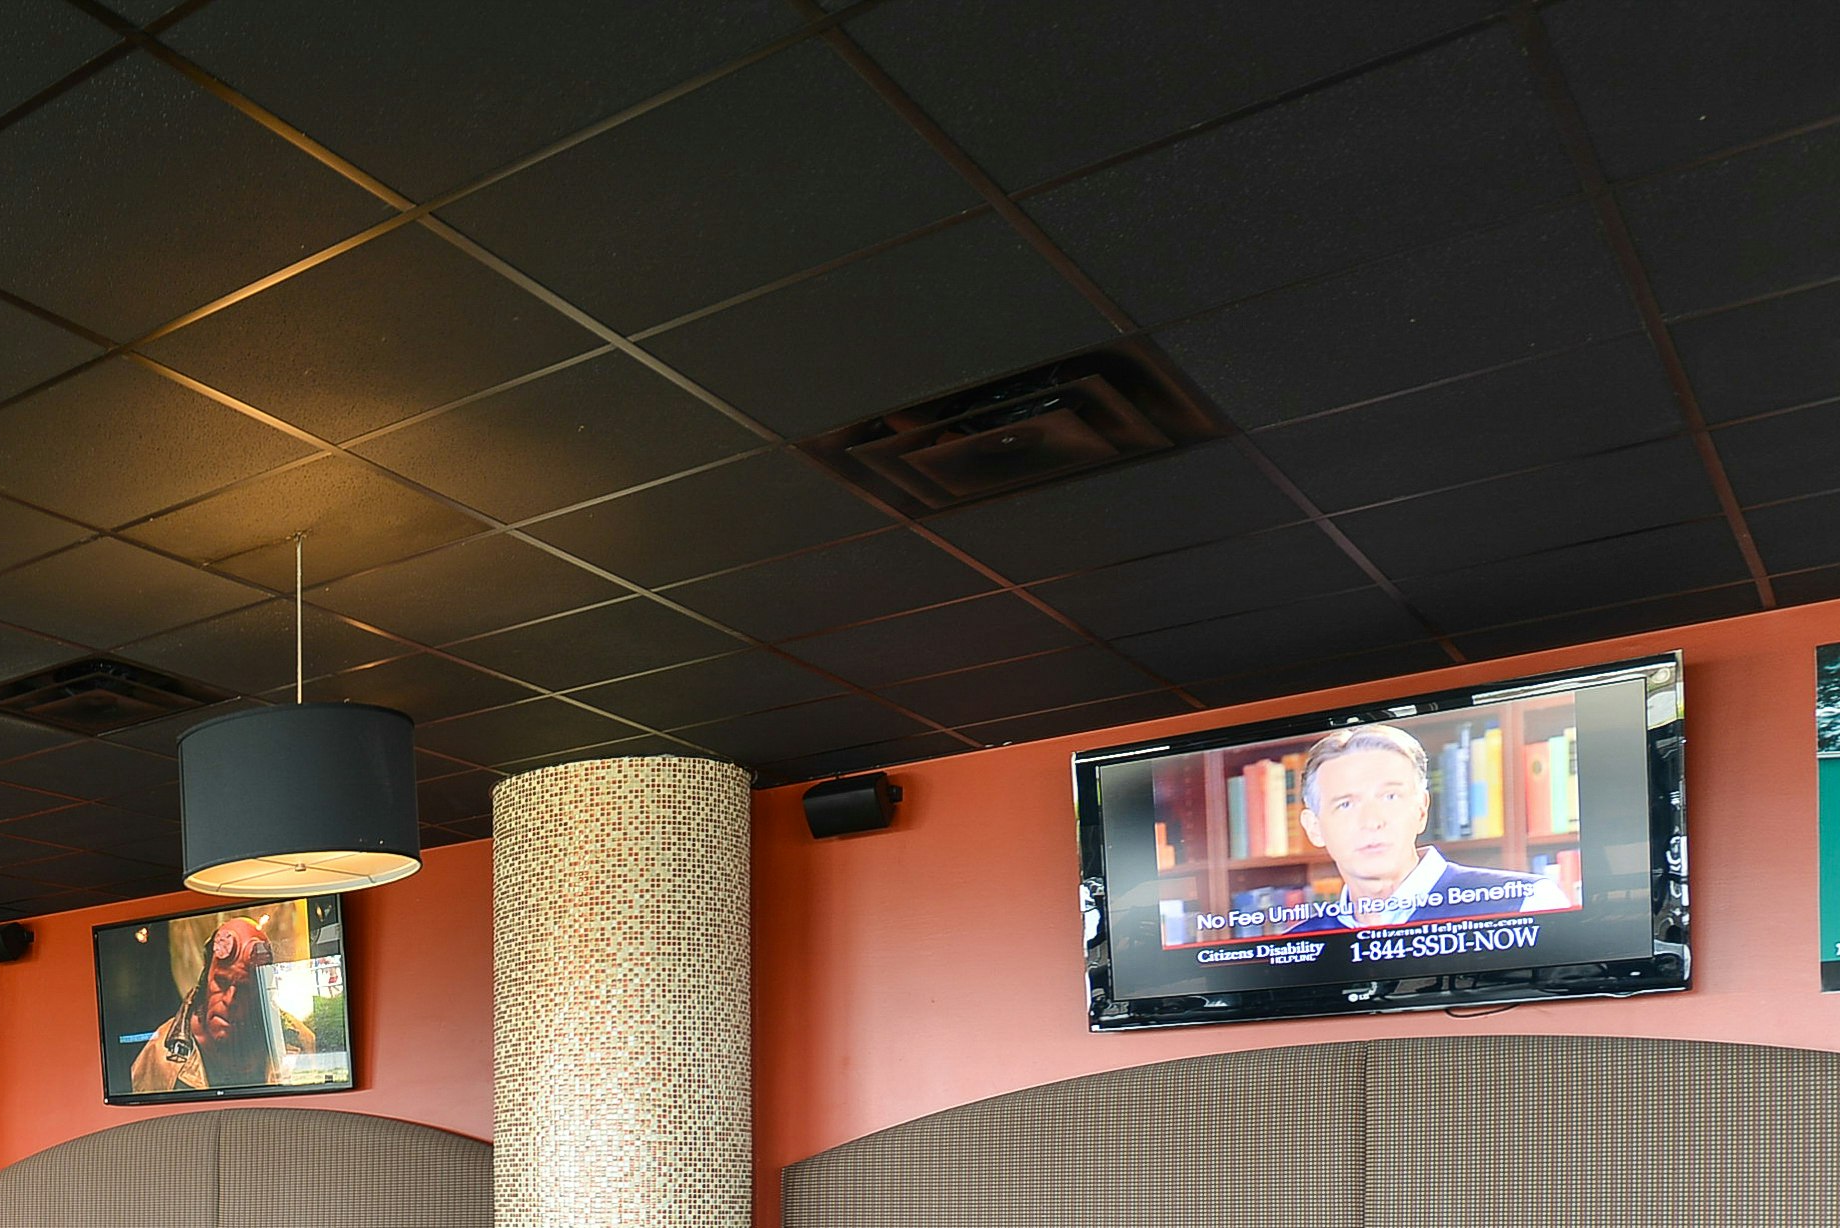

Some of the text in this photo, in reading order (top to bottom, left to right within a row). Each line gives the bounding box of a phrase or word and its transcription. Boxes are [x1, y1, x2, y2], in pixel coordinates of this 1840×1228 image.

[1196, 880, 1536, 931] No Fee Until You Receive Benefits
[1196, 940, 1326, 963] Citizens Disability
[1349, 925, 1540, 963] 1-844-SSDI-NOW
